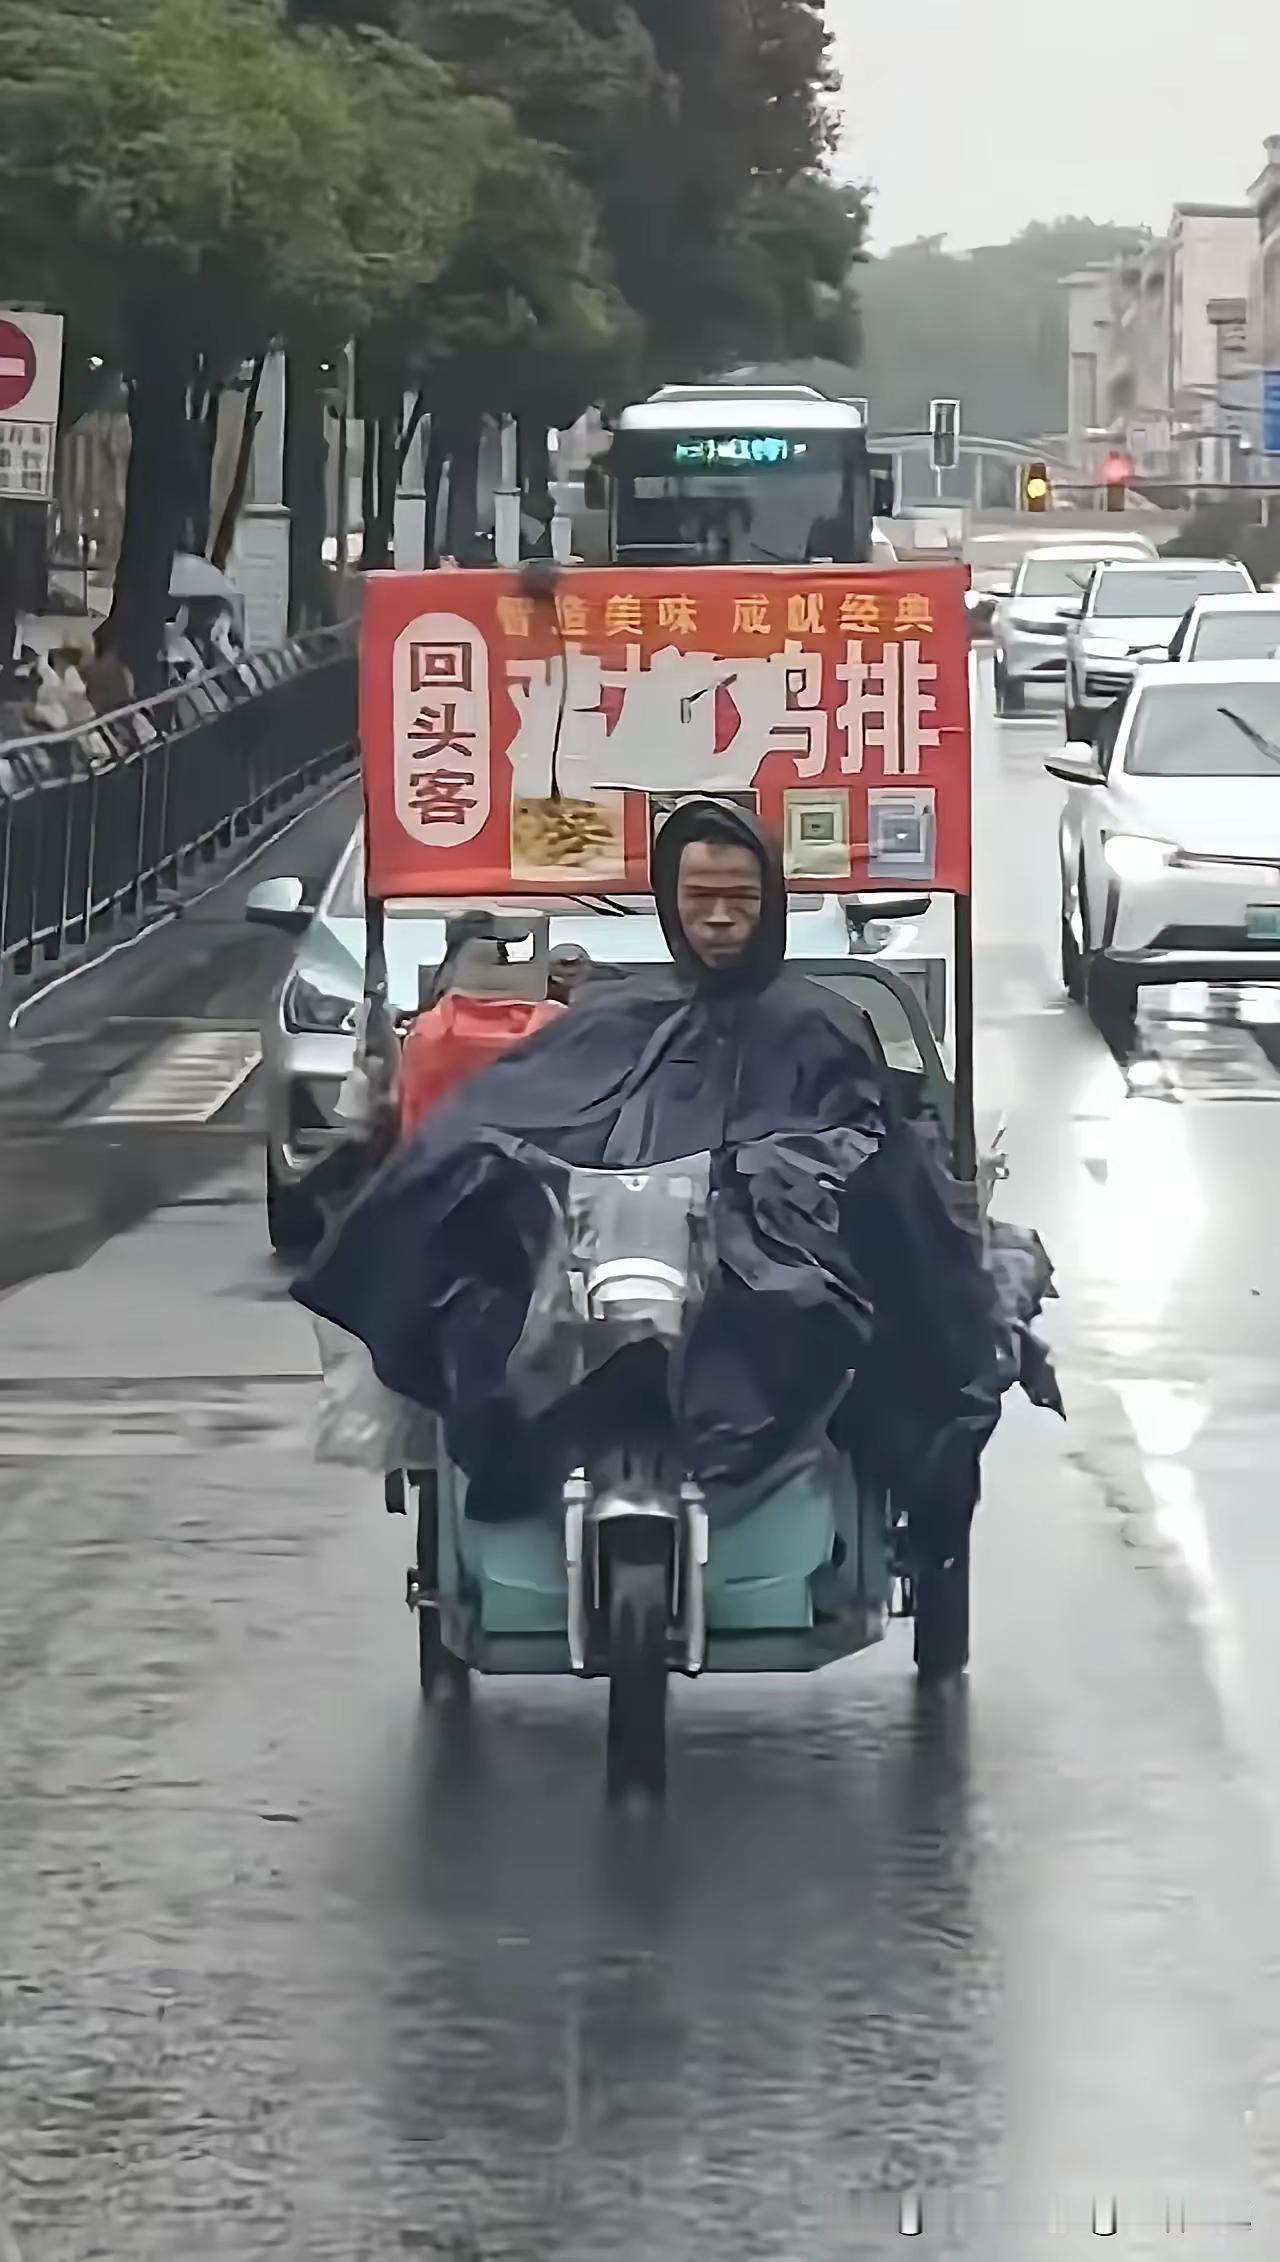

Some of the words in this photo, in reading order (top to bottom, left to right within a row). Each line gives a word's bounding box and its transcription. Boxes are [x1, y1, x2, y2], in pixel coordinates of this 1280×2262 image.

[732, 593, 933, 634] 成就经典
[407, 642, 478, 825] 回头客
